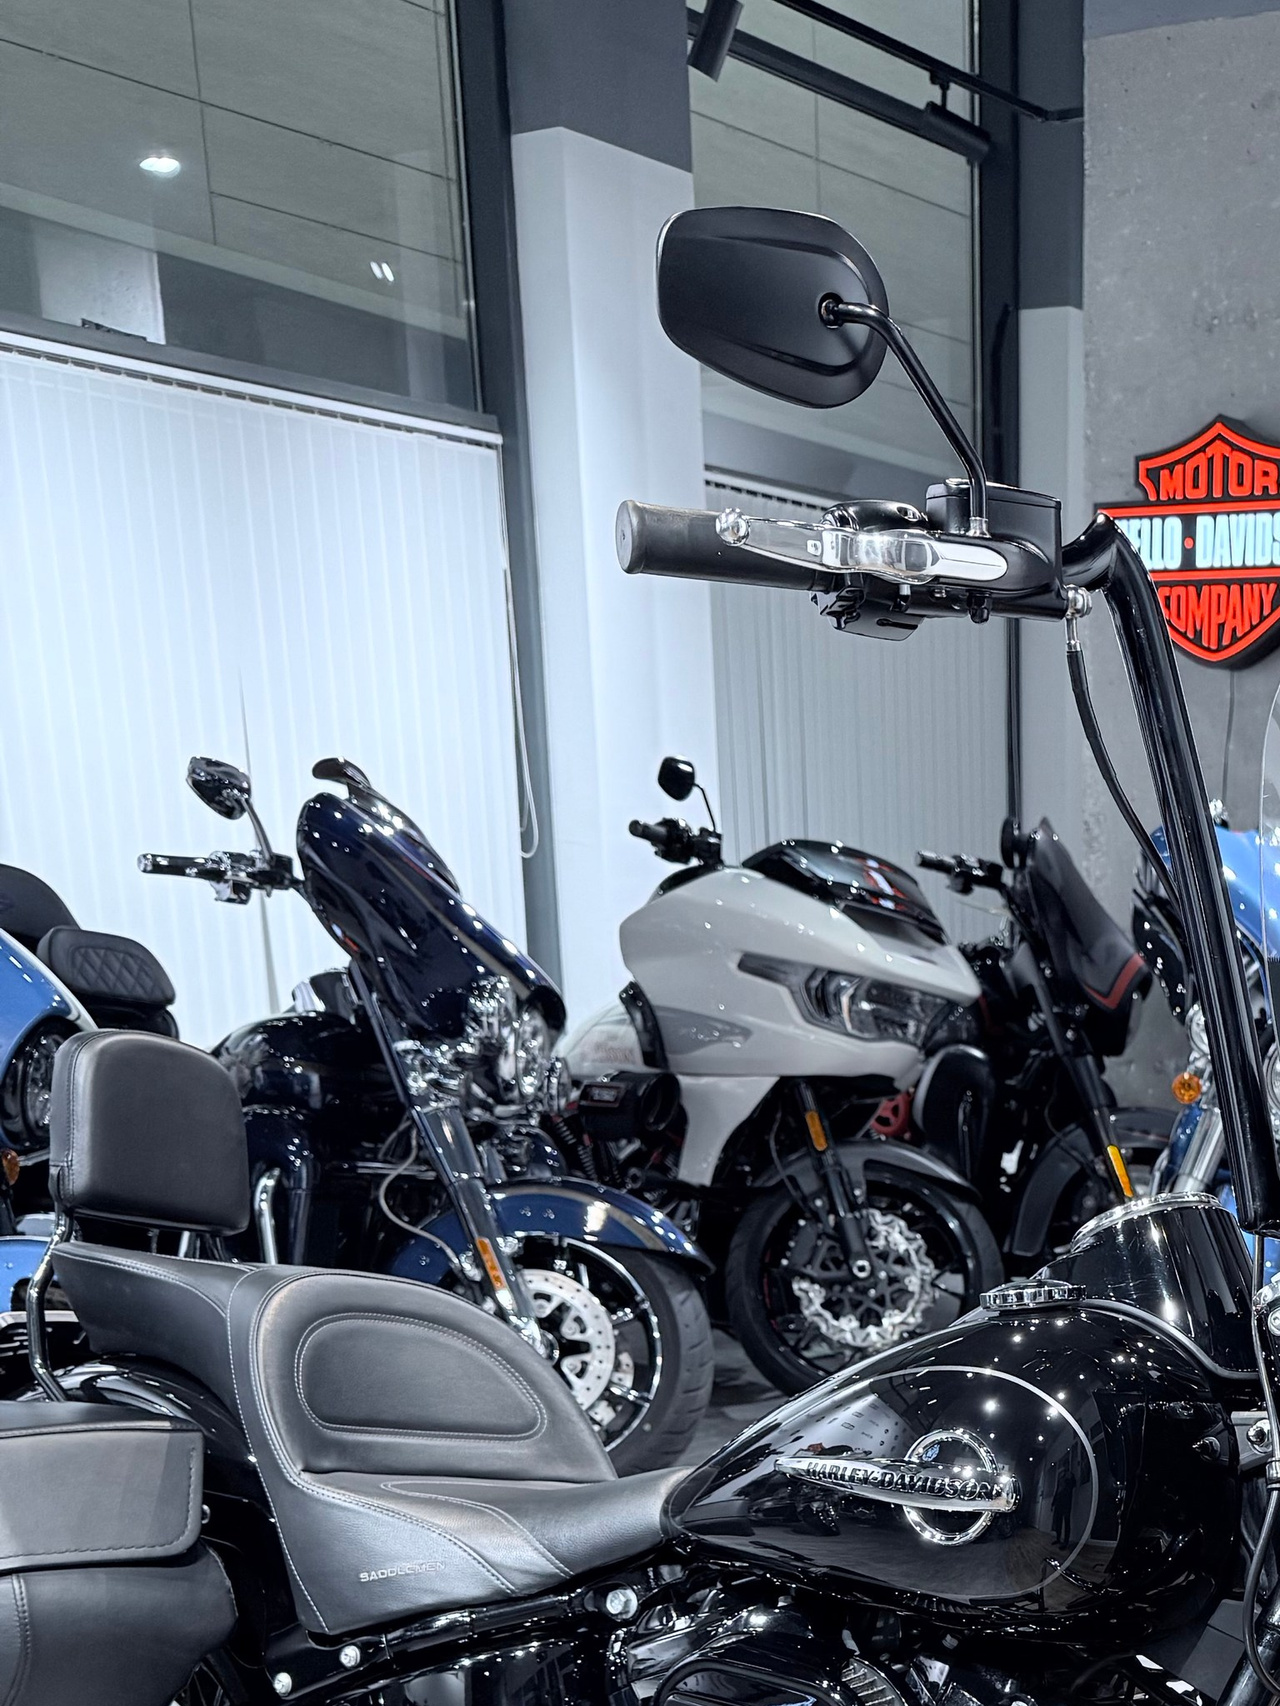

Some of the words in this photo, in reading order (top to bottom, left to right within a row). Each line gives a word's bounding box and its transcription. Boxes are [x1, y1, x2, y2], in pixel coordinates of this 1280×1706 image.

[1159, 439, 1280, 500] MOTOR
[1157, 583, 1278, 650] COMPANY
[805, 1461, 1003, 1501] HARLEY-DAVIDSON
[359, 1561, 446, 1582] SADDLEMEN
